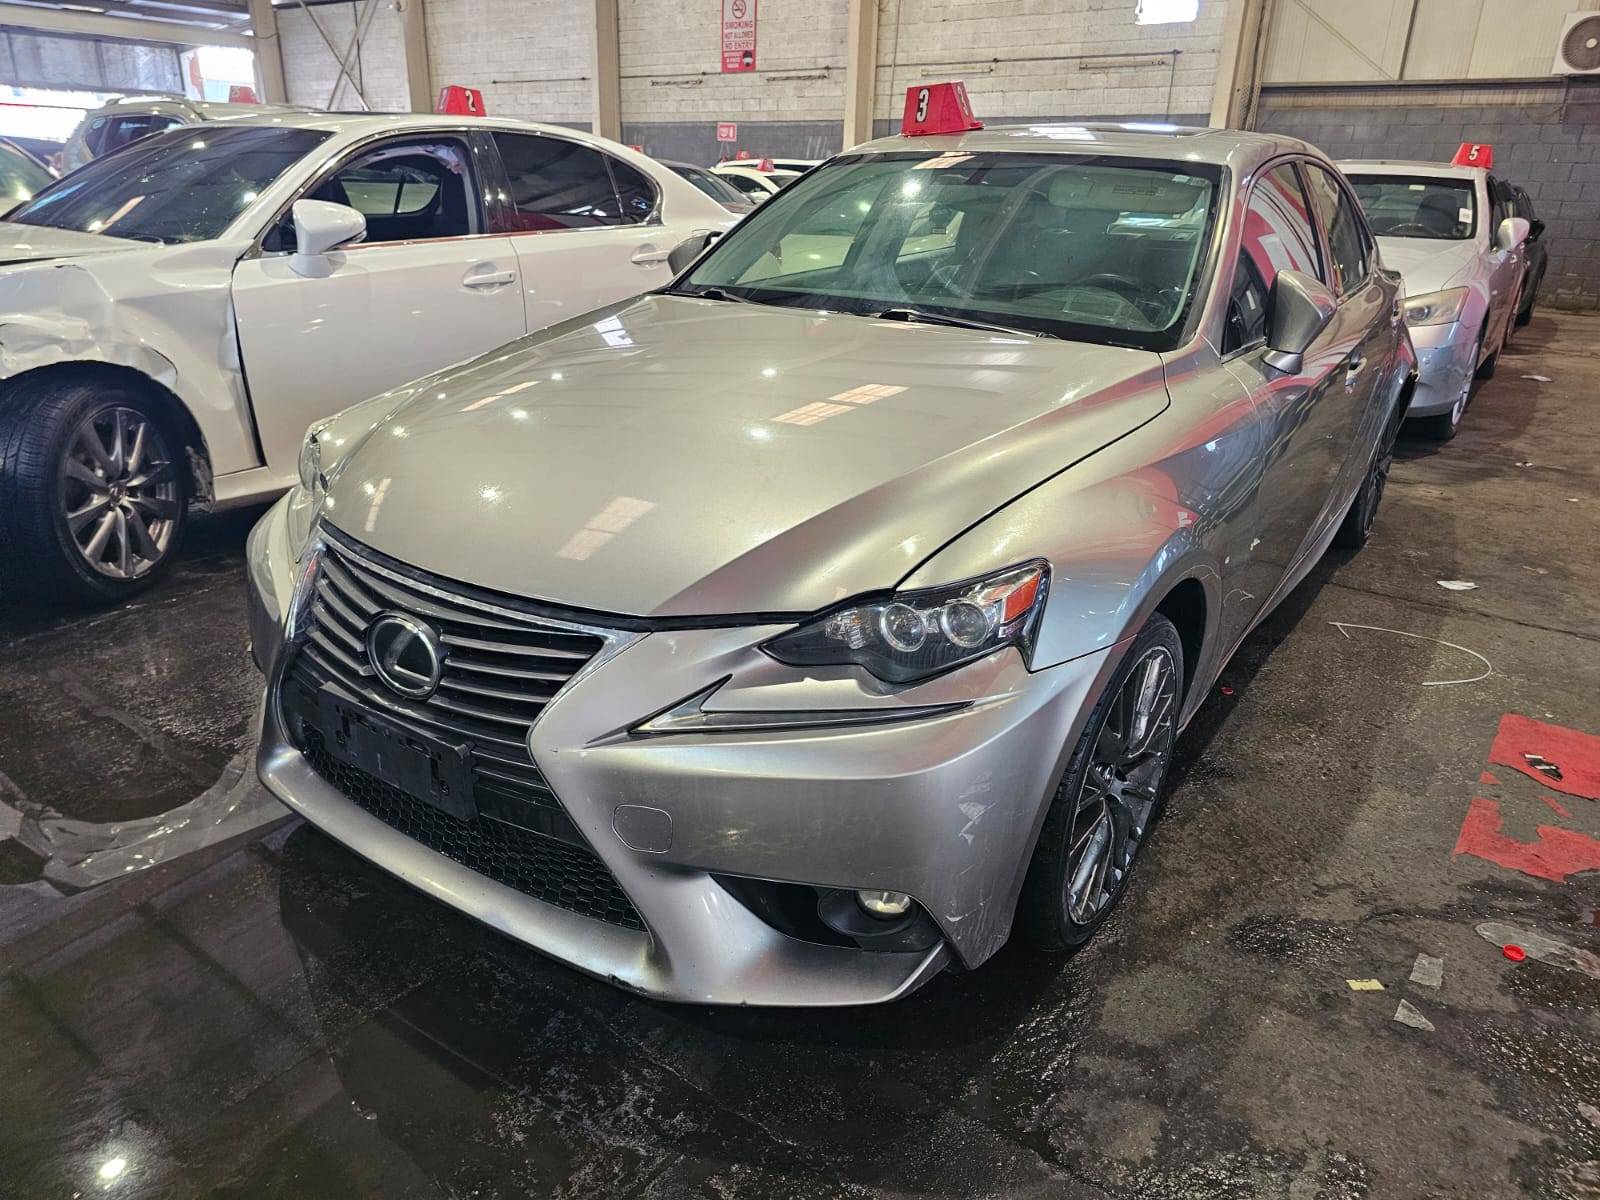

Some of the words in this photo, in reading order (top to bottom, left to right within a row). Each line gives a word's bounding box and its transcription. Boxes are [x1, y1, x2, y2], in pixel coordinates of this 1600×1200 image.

[725, 21, 753, 30] SMOKING
[725, 42, 733, 50] NO
[734, 41, 753, 50] ENTRY
[465, 89, 476, 112] 2
[916, 88, 930, 122] 3
[1468, 145, 1480, 161] 5
